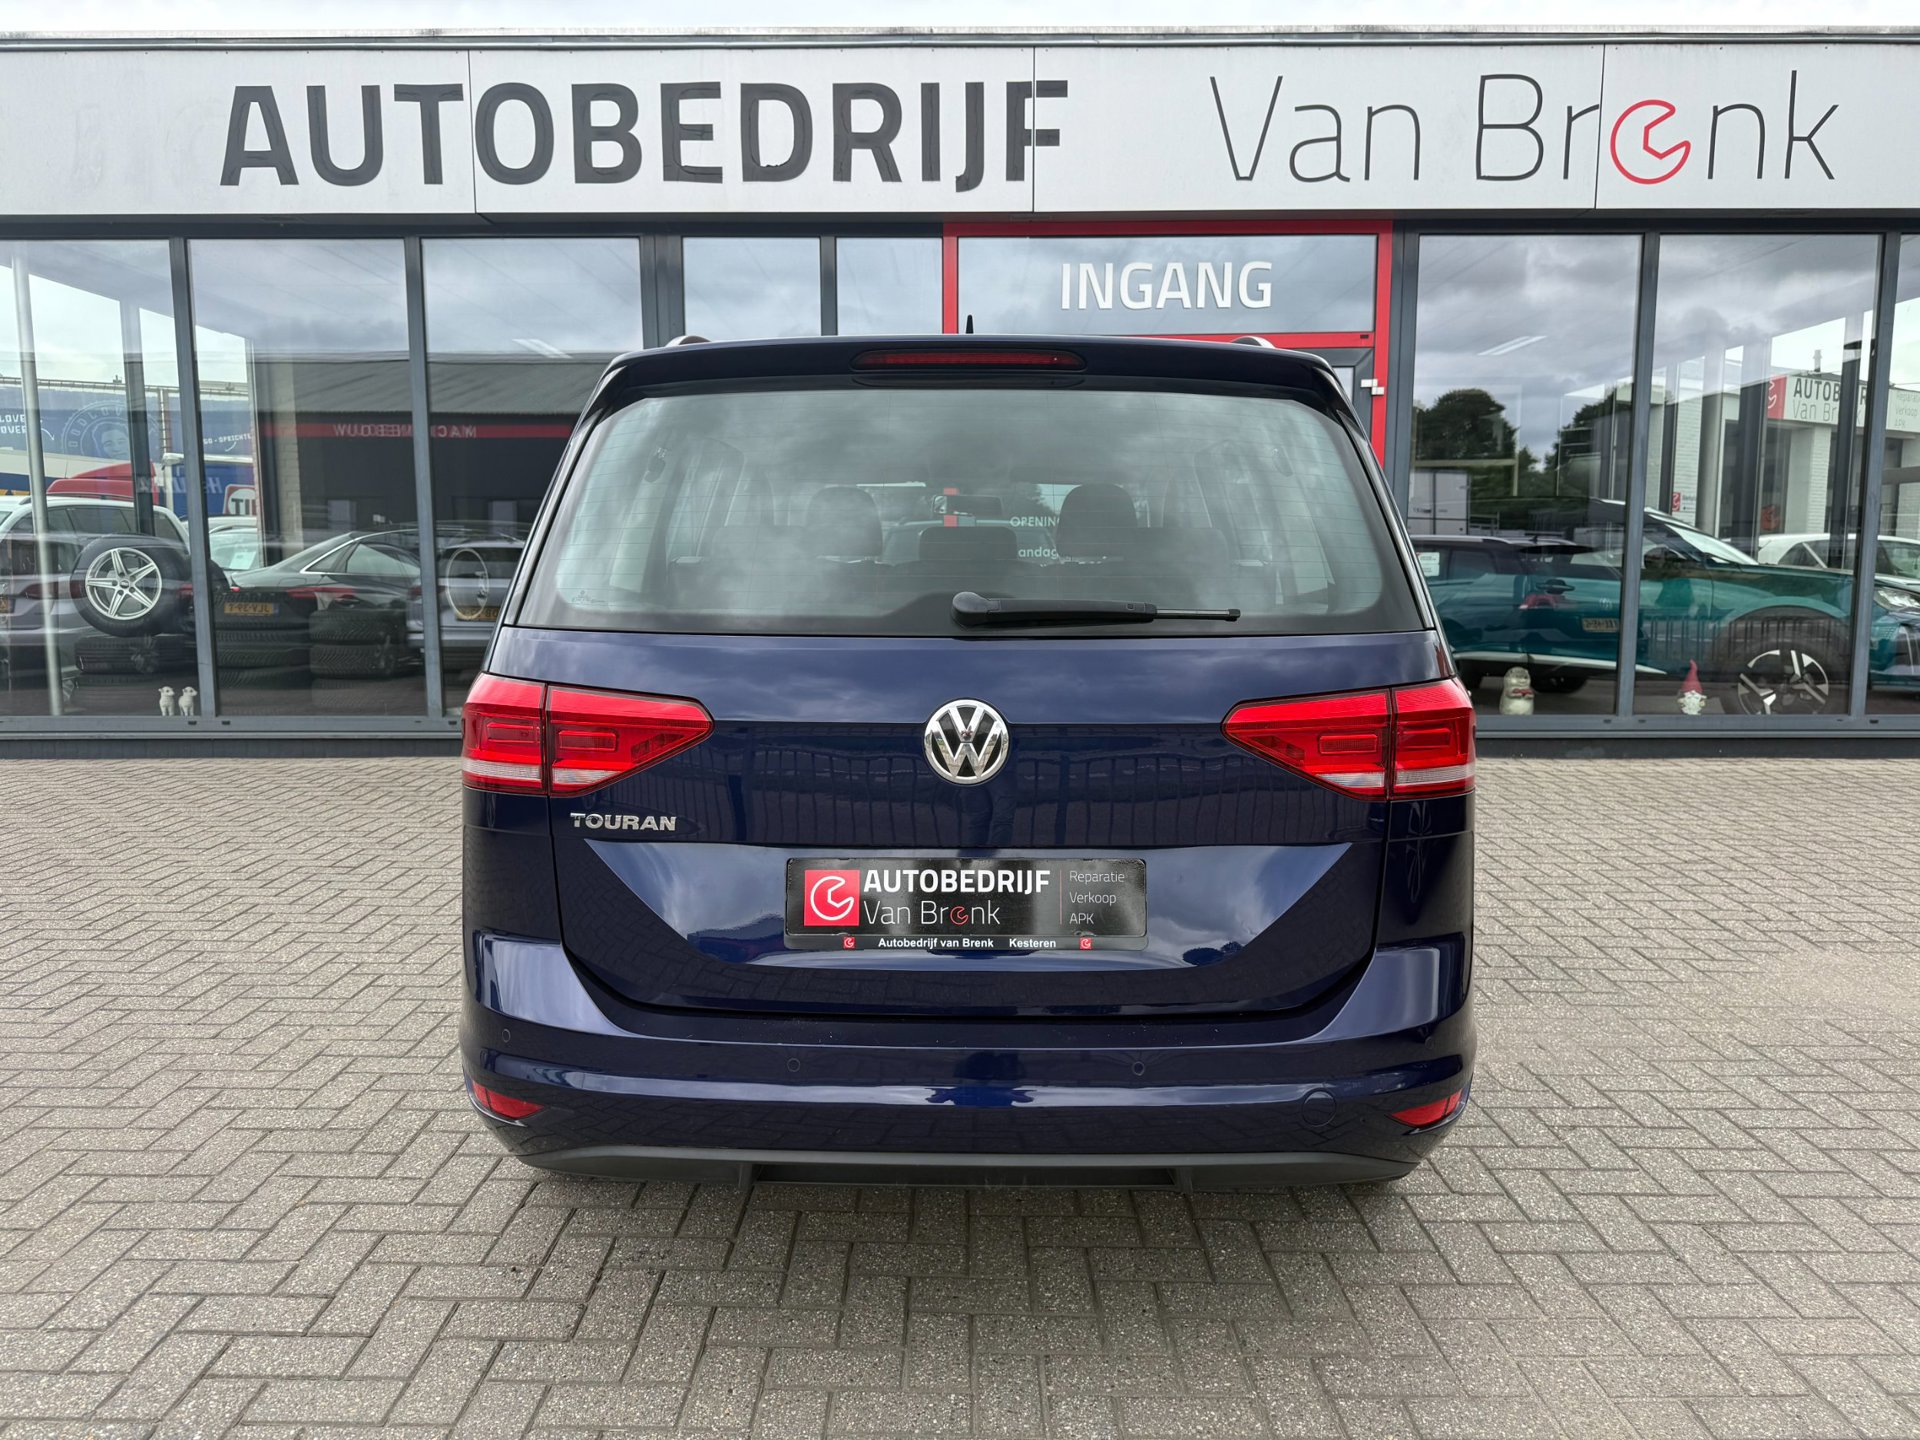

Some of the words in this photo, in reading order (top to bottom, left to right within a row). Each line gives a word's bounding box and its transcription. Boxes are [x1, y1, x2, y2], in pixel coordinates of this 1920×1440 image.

[220, 81, 1069, 193] AUTOBEDRIJF
[1210, 75, 1422, 184] Van
[1061, 261, 1273, 311] INGANG
[1010, 516, 1060, 527] OPENIN
[570, 812, 677, 831] TOURAN
[863, 869, 1051, 895] AUTOBEDRIJF
[1069, 870, 1125, 885] Reparatie
[1069, 892, 1117, 906] Verkoop
[863, 901, 911, 925] Van
[1069, 913, 1094, 925] APK
[878, 937, 938, 950] Autobedrijf
[940, 940, 959, 948] van
[962, 937, 994, 948] Brenk
[1009, 937, 1057, 948] Kesteren
